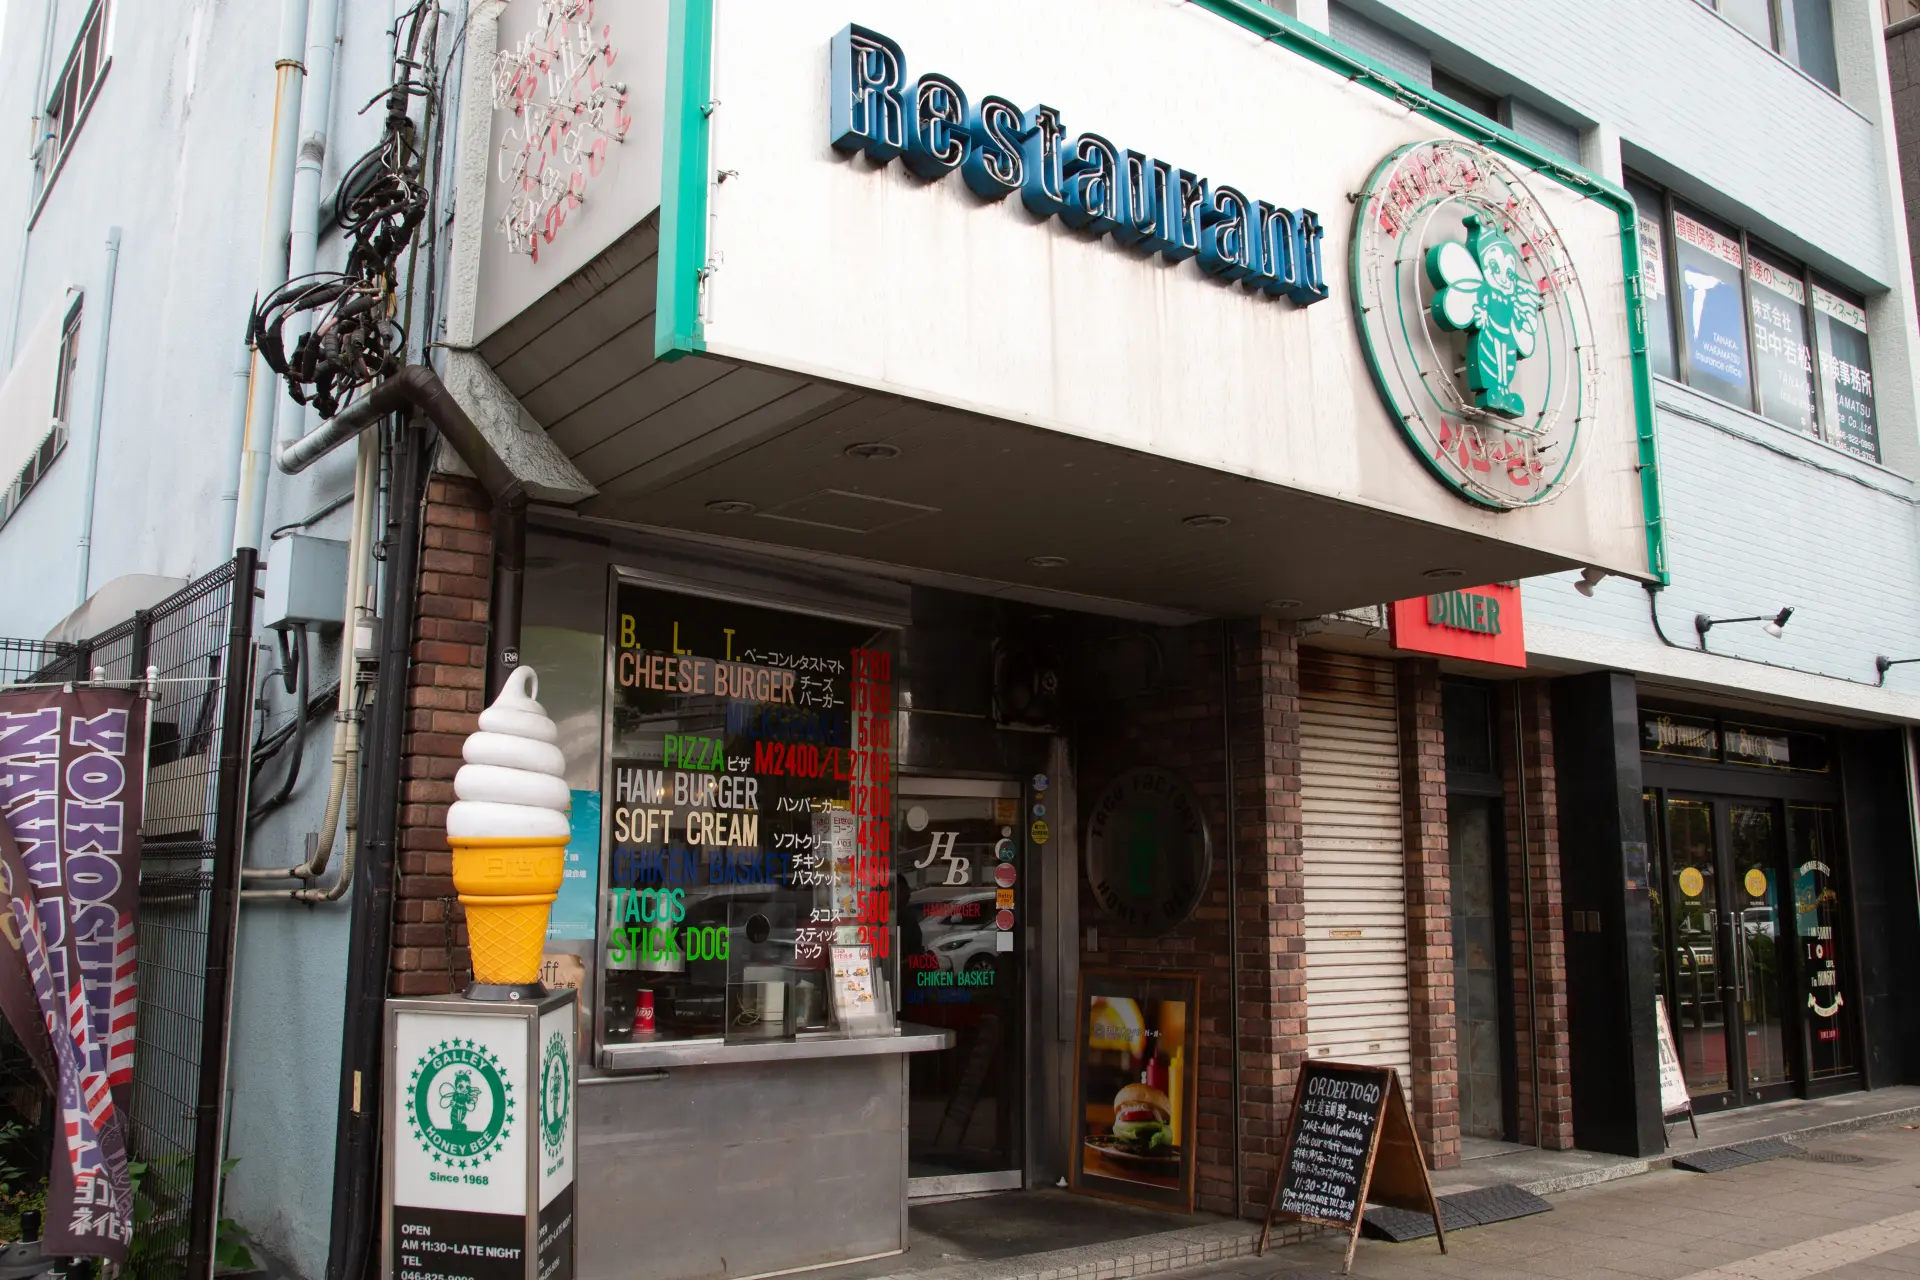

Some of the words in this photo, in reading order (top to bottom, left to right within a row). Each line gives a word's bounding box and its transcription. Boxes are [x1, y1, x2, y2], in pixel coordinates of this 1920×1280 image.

[832, 22, 1329, 308] Restaurant
[1752, 296, 1792, 333] 株式会社
[1755, 324, 1812, 374] 田中若松
[1427, 590, 1502, 634] DINER
[620, 614, 641, 648] B.
[673, 621, 692, 656] L.
[724, 629, 741, 662] T.
[744, 648, 845, 674] ベーコンレタストマト
[851, 648, 891, 683] 1280
[619, 653, 706, 695] CHEESE
[714, 663, 795, 705] BURGER
[800, 676, 833, 693] チーズ
[800, 690, 845, 708] バーガー
[851, 682, 891, 715] 1360
[858, 716, 891, 749] 500
[663, 734, 725, 772] PIZZA
[727, 756, 751, 772] ピザ
[616, 767, 662, 806] HAM
[674, 775, 758, 811] BURGER
[777, 796, 844, 814] ハンバーガー
[850, 785, 890, 818] 1200
[1132, 774, 1198, 835] FACTORY
[615, 808, 674, 846] SOFT
[686, 810, 758, 848] CREAM
[857, 820, 890, 853] 450
[709, 852, 791, 886] BASKET
[792, 855, 825, 870] チキン
[792, 870, 841, 887] バスケット
[849, 855, 890, 889] 1480
[614, 887, 686, 923] TACOS
[810, 907, 841, 924] タコス
[857, 890, 890, 924] 580
[1096, 879, 1151, 926] HONEY
[611, 926, 680, 963] STICK
[686, 926, 730, 961] DOG
[907, 954, 939, 969] TACOS
[916, 971, 954, 987] CHIKEN
[957, 970, 997, 987] BASKET
[432, 1049, 488, 1070] GALLEY
[1308, 1076, 1349, 1100] ORDER
[425, 1124, 467, 1155] HONEY
[469, 1129, 494, 1152] BEE
[1296, 1132, 1311, 1146] Ask
[1310, 1137, 1324, 1147] our
[429, 1172, 460, 1184] Since
[462, 1173, 489, 1186] 1968
[401, 1223, 431, 1236] OPEN
[401, 1239, 419, 1250] AM
[486, 1246, 521, 1259] NIGHT
[401, 1255, 422, 1267] TEL
